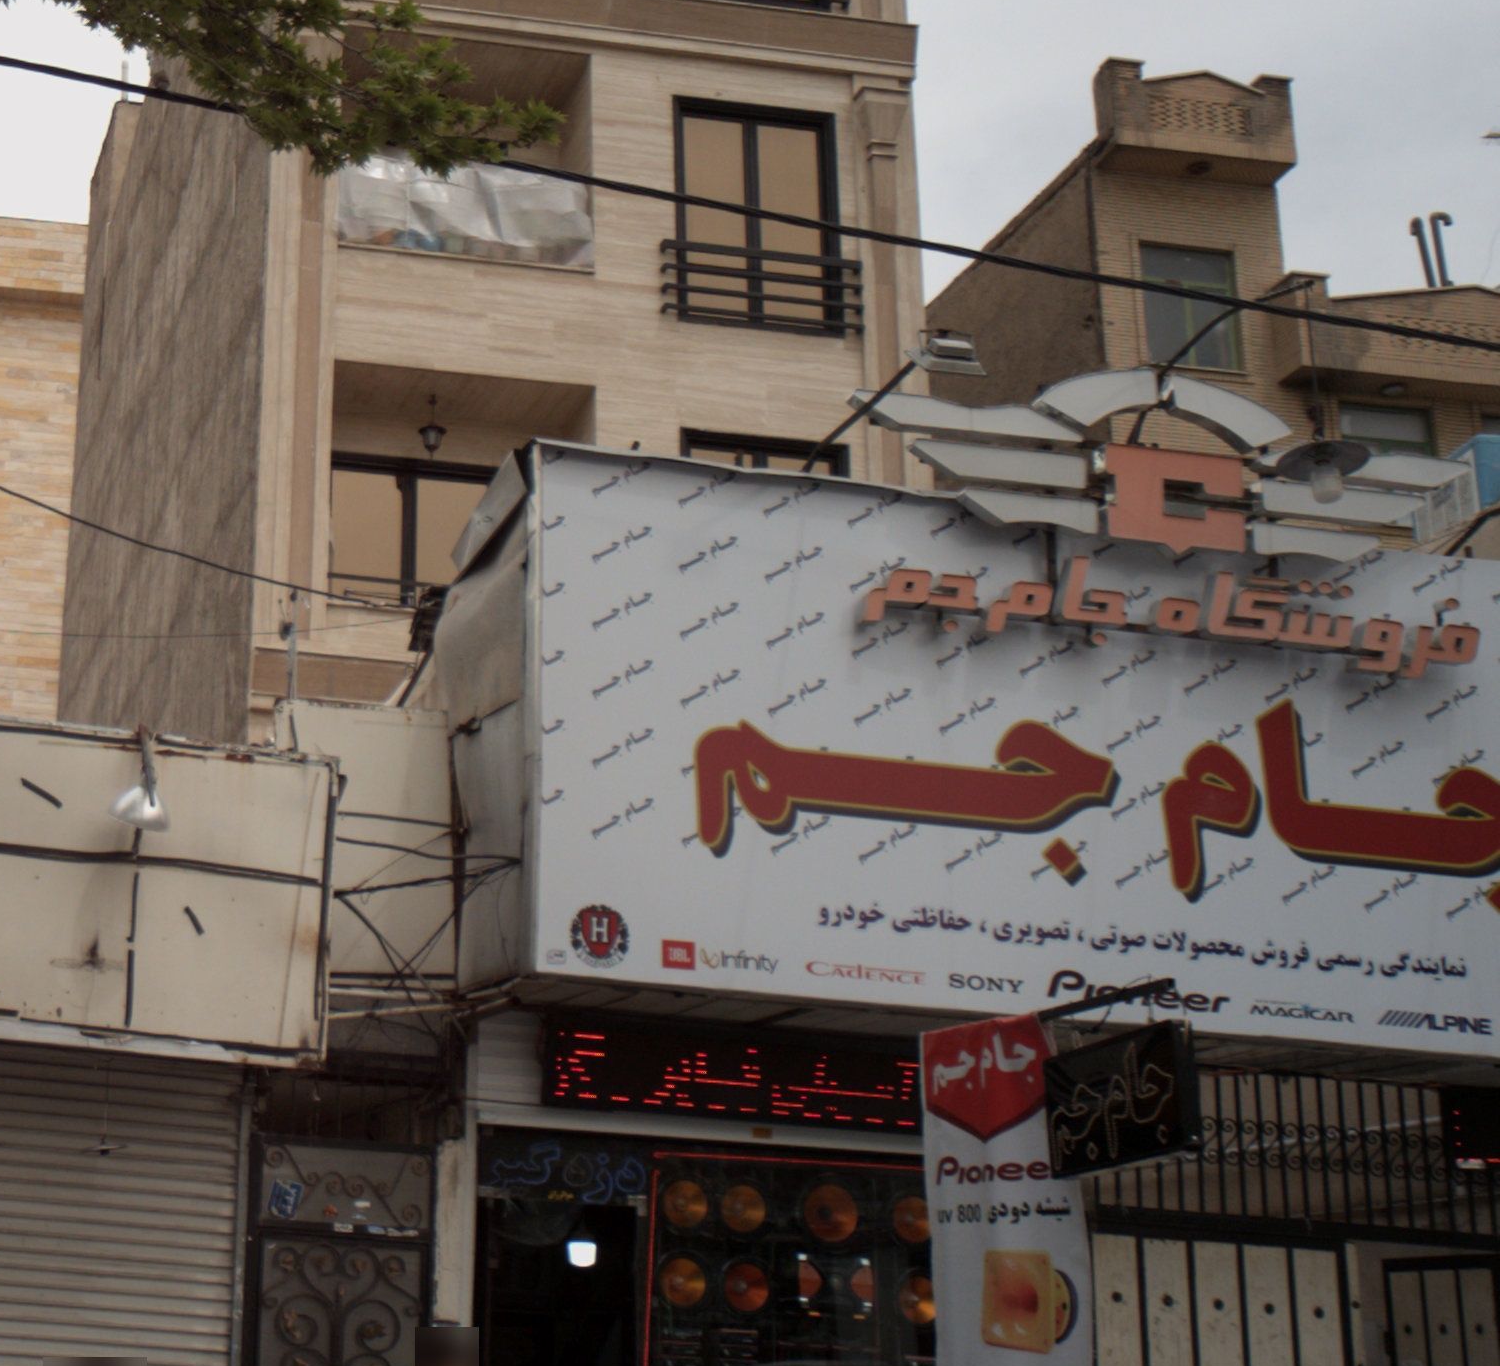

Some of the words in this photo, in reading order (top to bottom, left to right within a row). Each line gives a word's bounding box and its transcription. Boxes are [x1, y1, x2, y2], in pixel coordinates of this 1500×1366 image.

[858, 568, 979, 634] جم
[985, 555, 1129, 647] جام
[693, 718, 1120, 887] جم
[1161, 697, 1500, 915] جام
[817, 900, 885, 930] خودرو
[892, 906, 972, 933] حفاظتی
[992, 920, 1071, 946] تصویری
[1090, 925, 1147, 953] صوتی
[1152, 931, 1246, 961] محصولات
[1251, 939, 1311, 969] فروش
[1316, 953, 1374, 977] رسمی
[1380, 952, 1468, 981] نمایندگی
[720, 948, 779, 975] Infinity
[948, 972, 1025, 994] SONY
[931, 1048, 977, 1096] جم
[979, 1033, 1037, 1089] جام
[1104, 1040, 1175, 1160] جام
[1050, 1083, 1103, 1173] جم
[935, 1155, 1051, 1186] Pionee
[957, 1202, 982, 1224] 800
[987, 1201, 1031, 1224] دودی
[1034, 1195, 1072, 1222] شیشه
